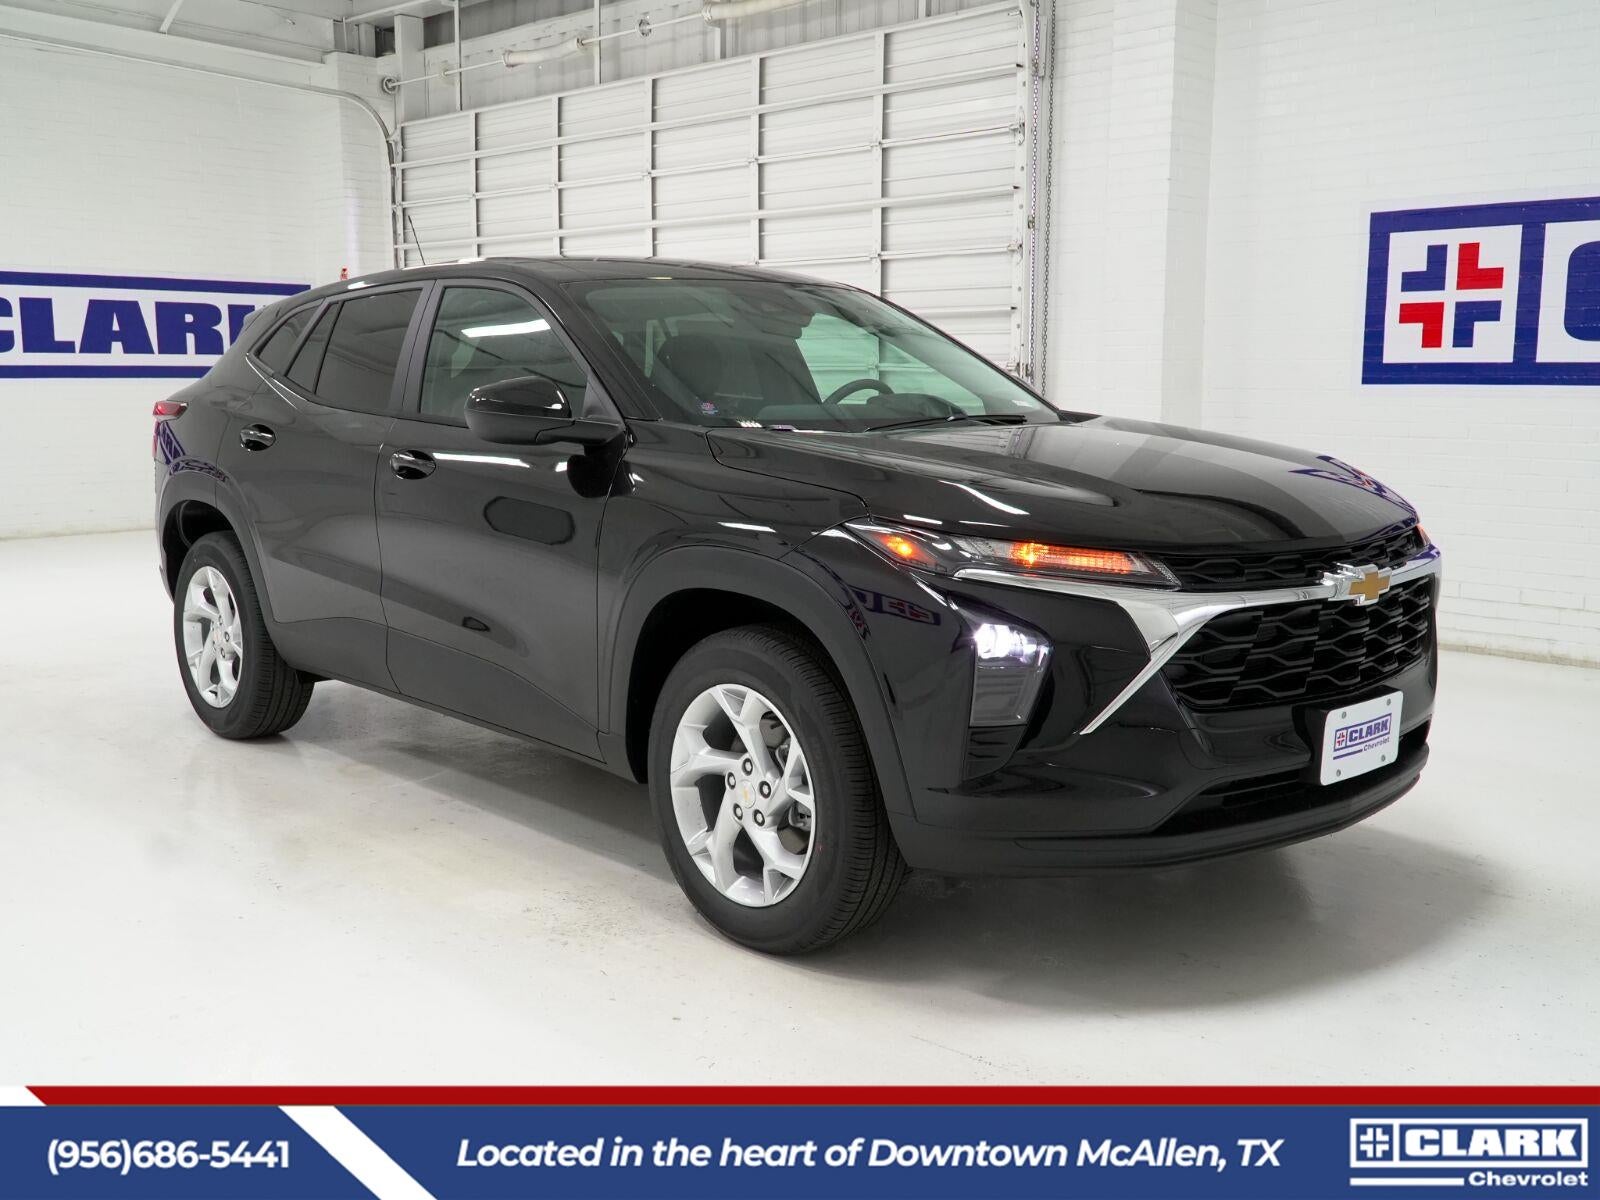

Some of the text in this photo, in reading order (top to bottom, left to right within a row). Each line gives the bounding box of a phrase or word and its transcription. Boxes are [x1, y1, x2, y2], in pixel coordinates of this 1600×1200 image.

[0, 296, 256, 356] LAR
[1348, 718, 1389, 743] CLARK
[1363, 736, 1390, 752] Chevrolet
